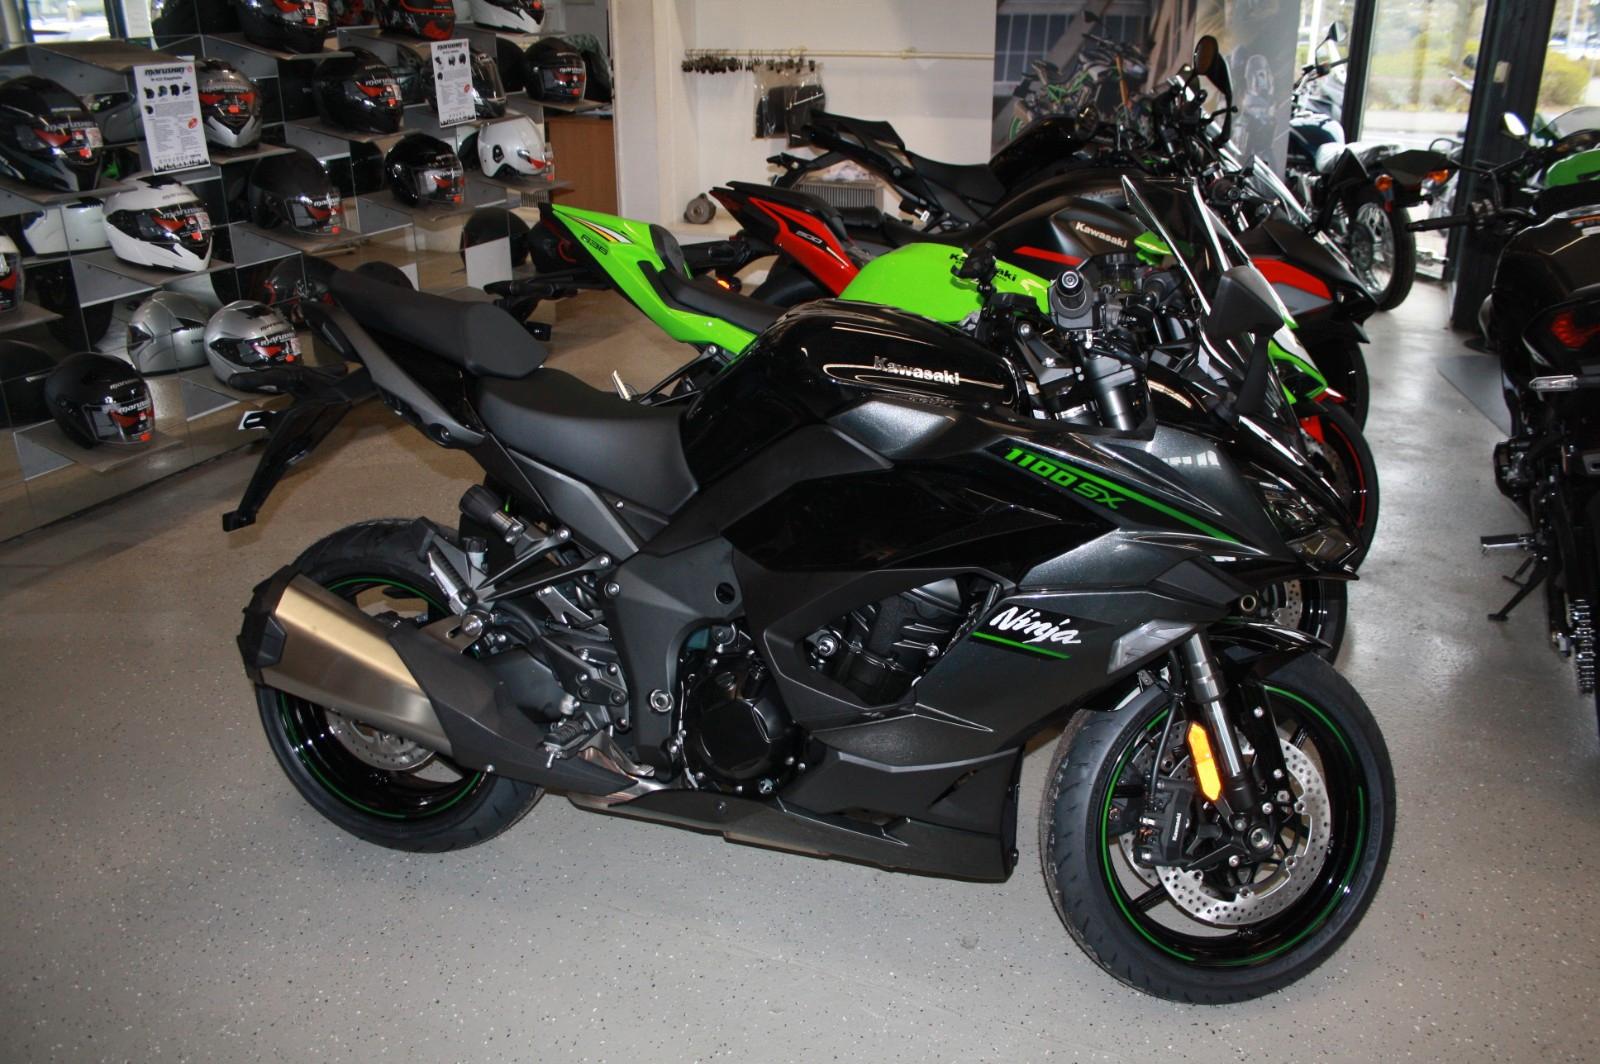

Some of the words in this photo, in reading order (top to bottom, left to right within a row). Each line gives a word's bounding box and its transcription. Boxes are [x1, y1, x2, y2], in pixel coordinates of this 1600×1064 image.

[1075, 221, 1128, 248] Kawasaki
[873, 355, 960, 386] Kawasaki
[1004, 448, 1078, 487] 1100
[1071, 481, 1127, 510] SX
[989, 605, 1082, 645] Ninja
